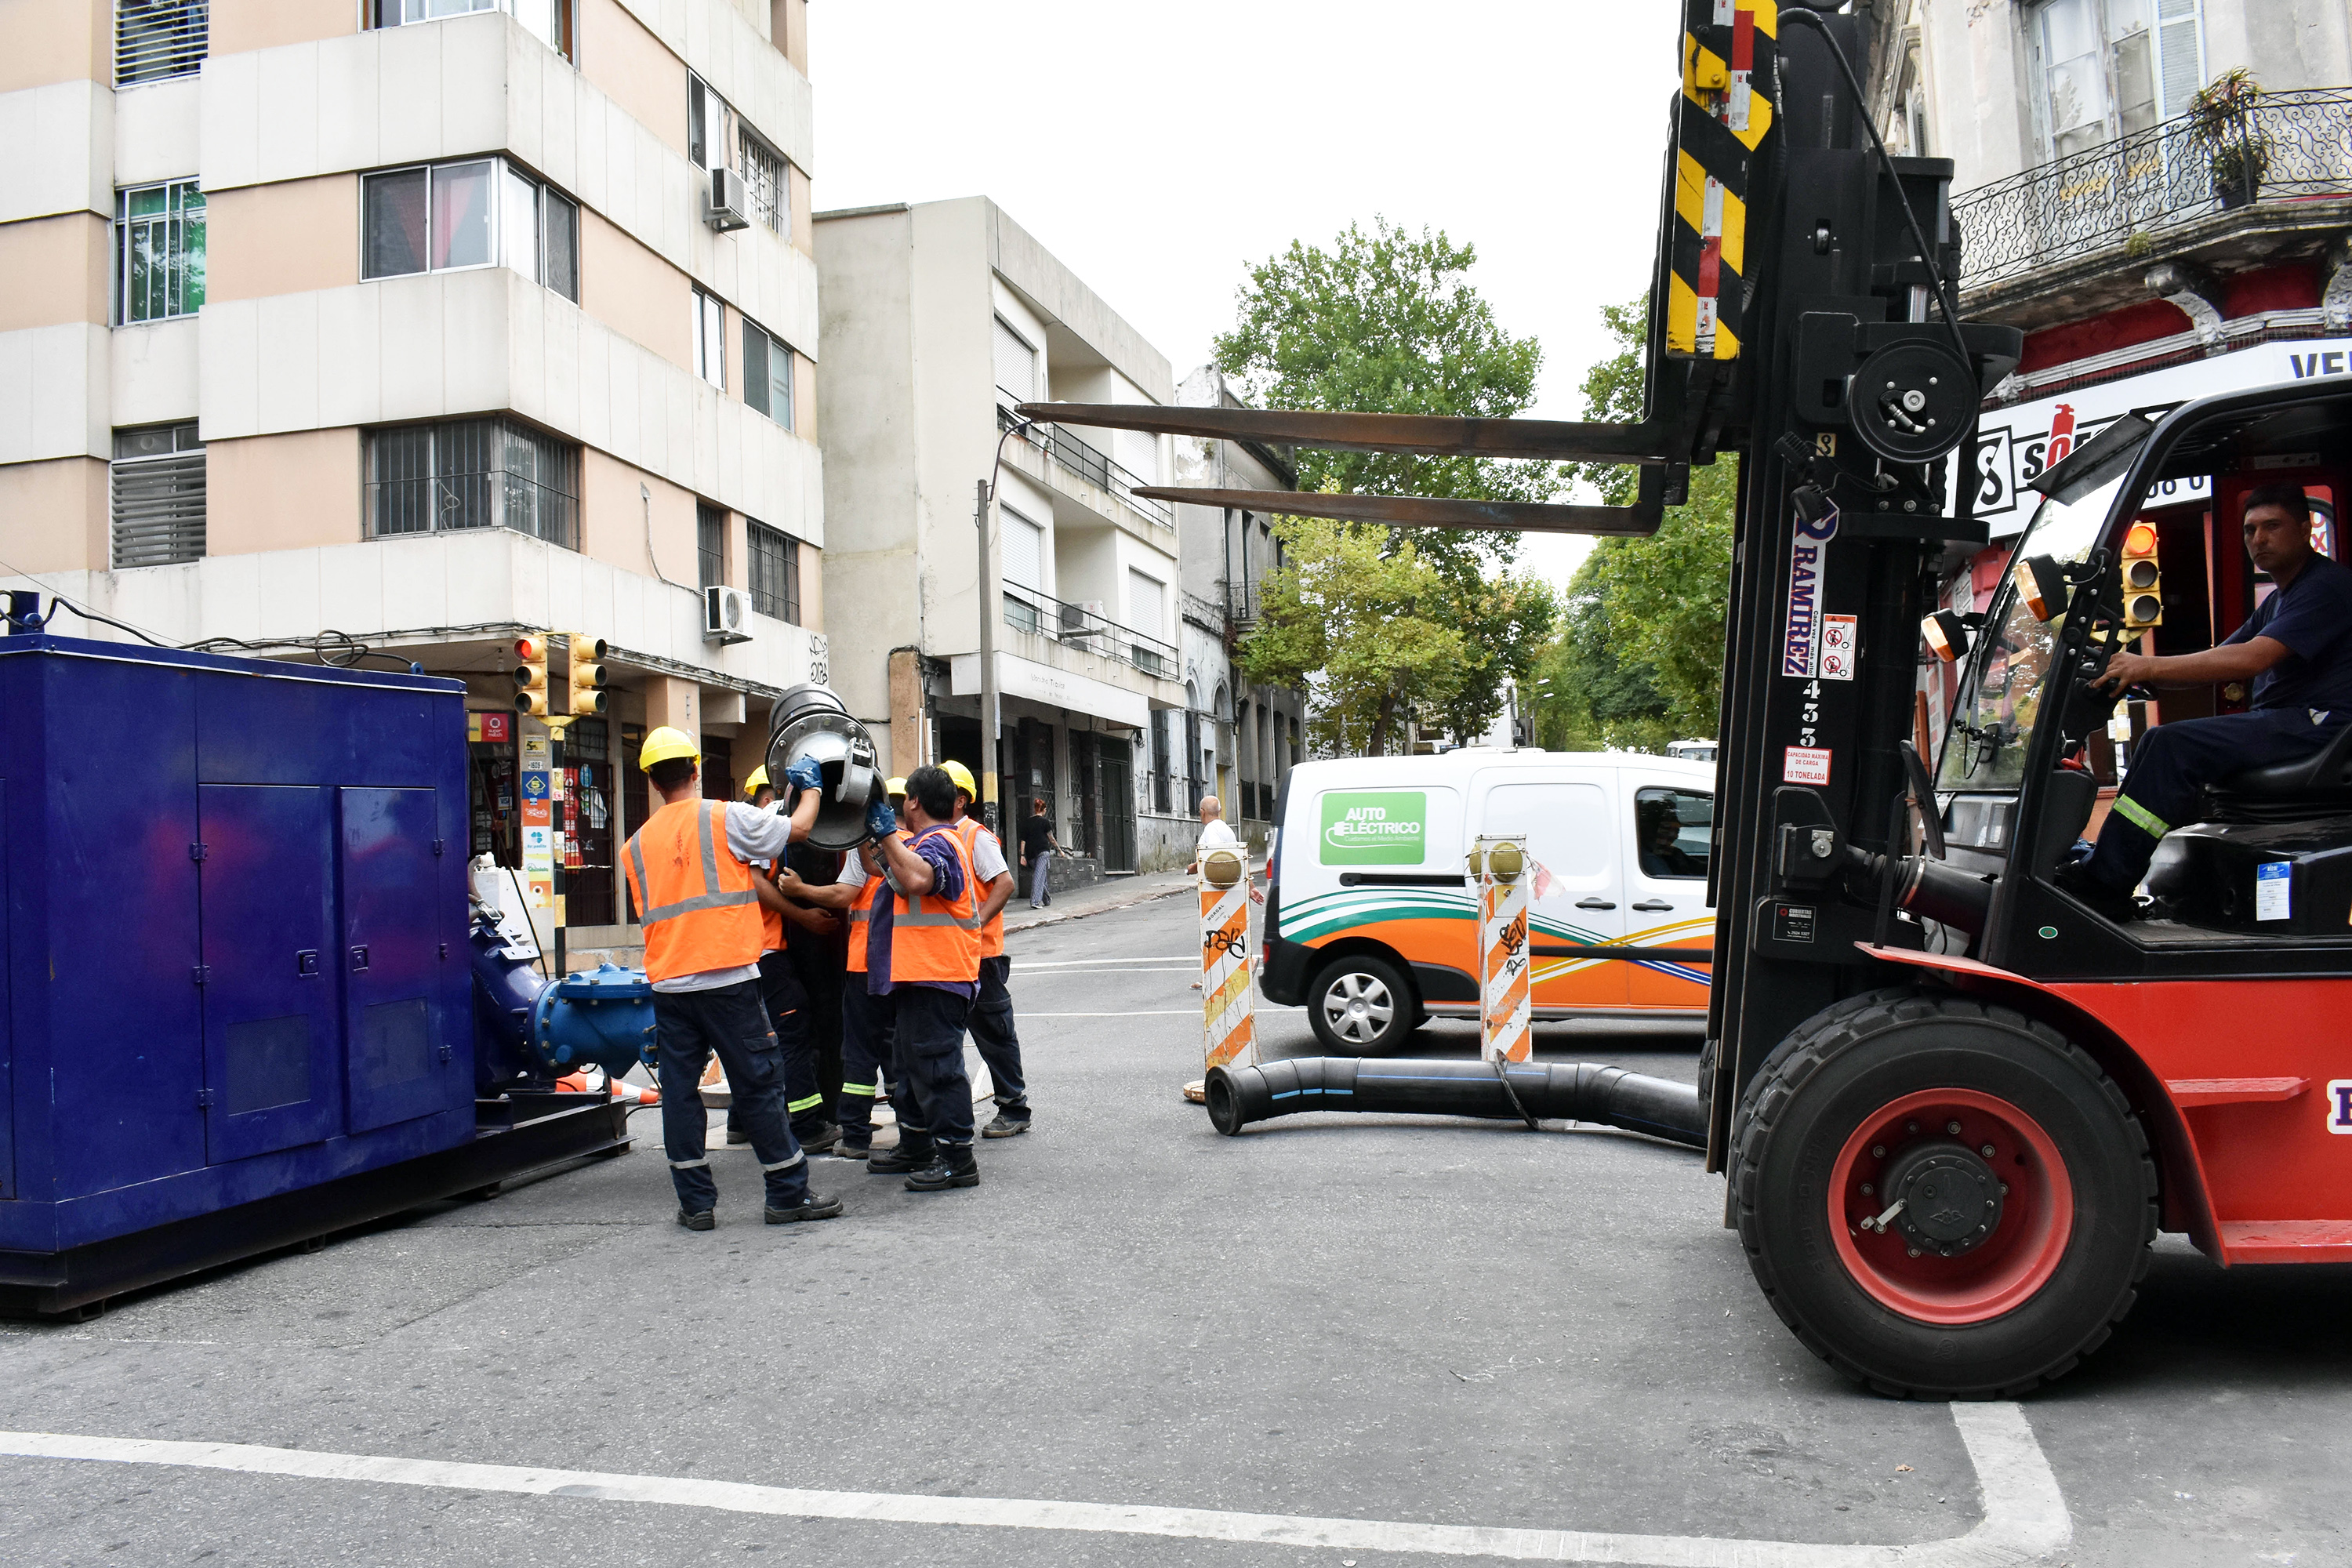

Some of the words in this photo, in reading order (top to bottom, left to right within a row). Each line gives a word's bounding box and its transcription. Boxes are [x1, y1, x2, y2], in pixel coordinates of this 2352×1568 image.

[1784, 544, 1818, 677] RAMIREZ
[1795, 771, 1825, 781] TONELADA
[1345, 807, 1386, 821] AUTO
[1343, 820, 1421, 835] ELÉCTRICO
[1207, 905, 1225, 921] MORGAL
